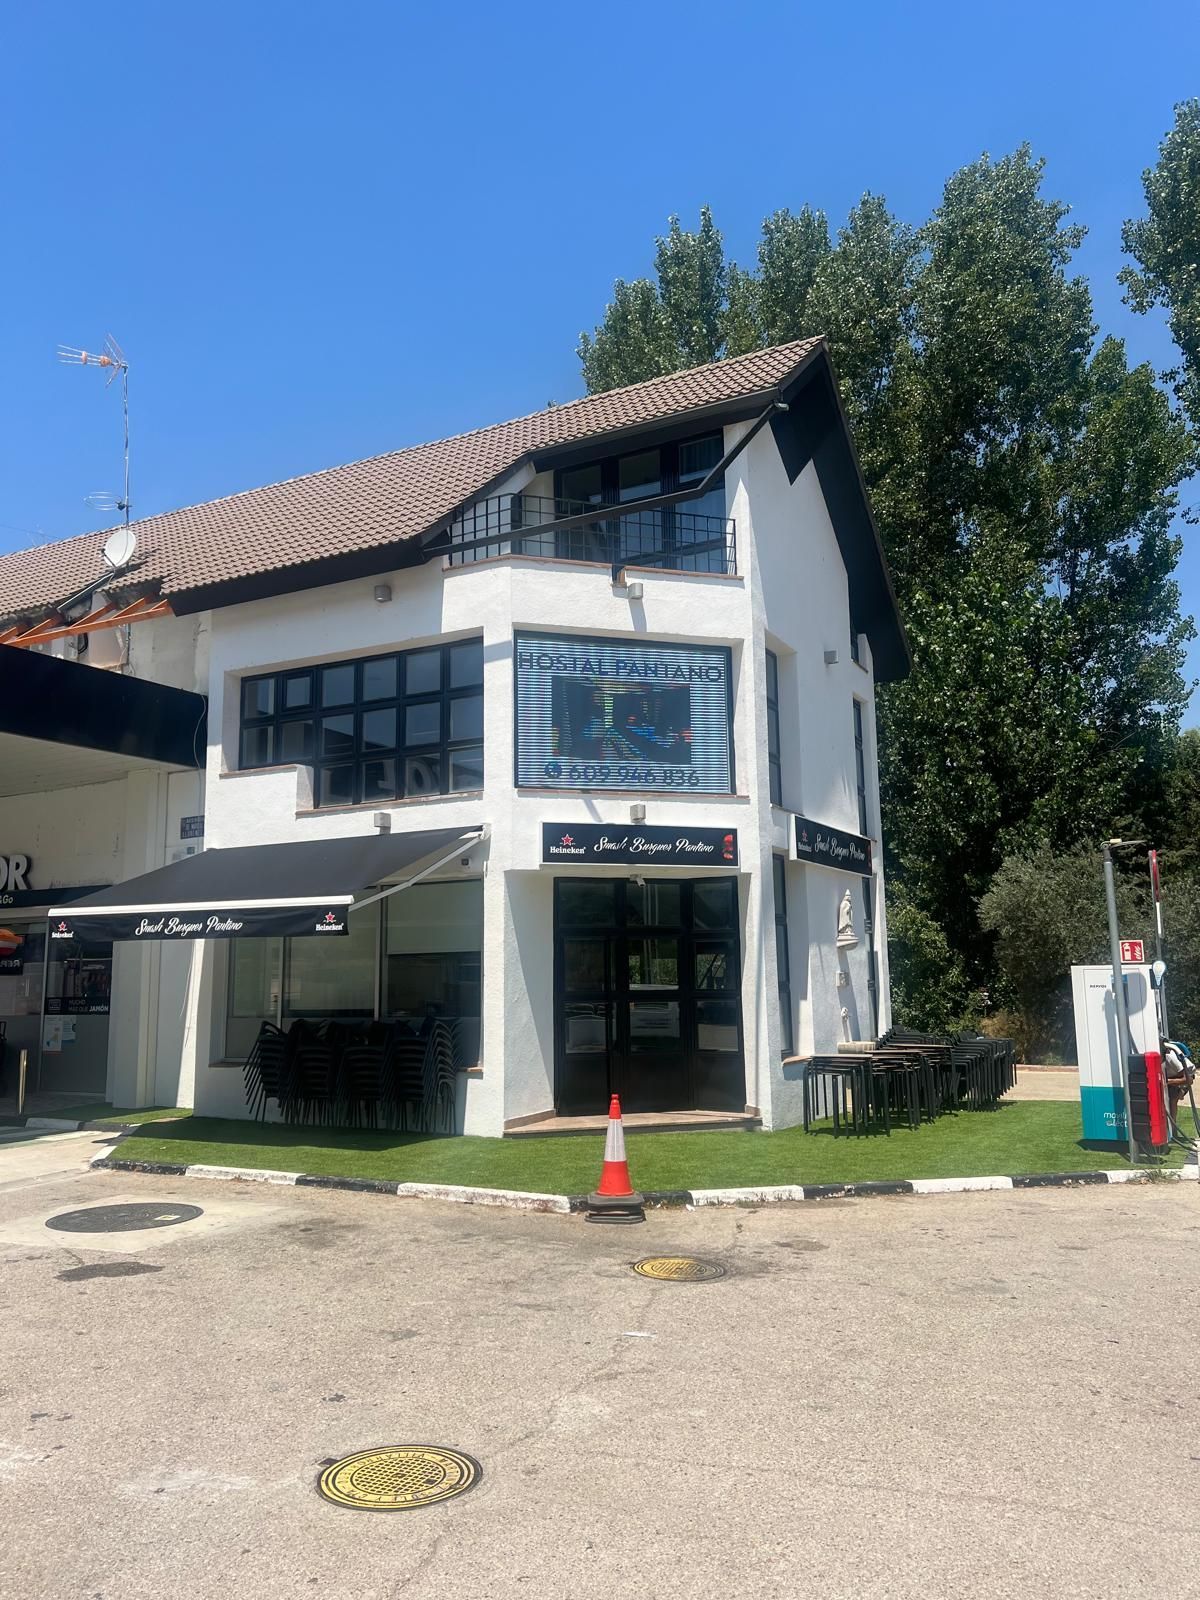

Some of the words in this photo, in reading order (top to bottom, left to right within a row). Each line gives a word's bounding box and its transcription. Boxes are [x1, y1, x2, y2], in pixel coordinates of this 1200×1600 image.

[518, 651, 608, 676] HOSTAL
[616, 659, 723, 683] PANTANO
[550, 846, 585, 854] Heineken
[594, 836, 628, 851] Smash
[676, 838, 714, 853] Pantano
[135, 917, 164, 936] Smash
[205, 915, 244, 933] Pantano
[316, 922, 344, 931] Heineken
